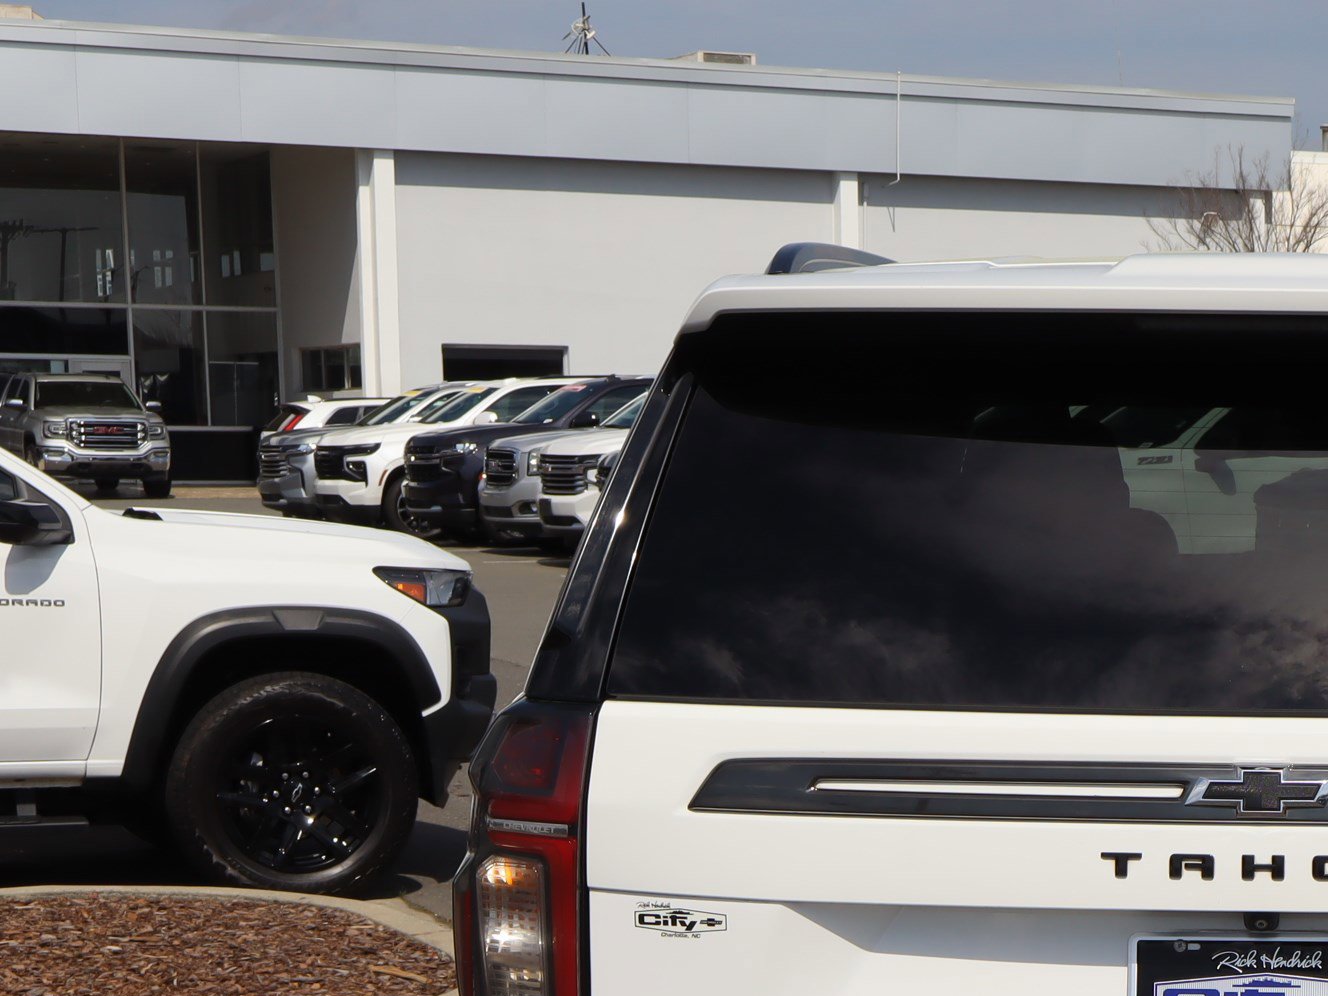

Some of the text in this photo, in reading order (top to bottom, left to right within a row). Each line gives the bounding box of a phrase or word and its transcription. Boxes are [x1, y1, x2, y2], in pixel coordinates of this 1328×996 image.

[638, 914, 697, 931] City
[1211, 946, 1323, 973] Rick Hendrick
